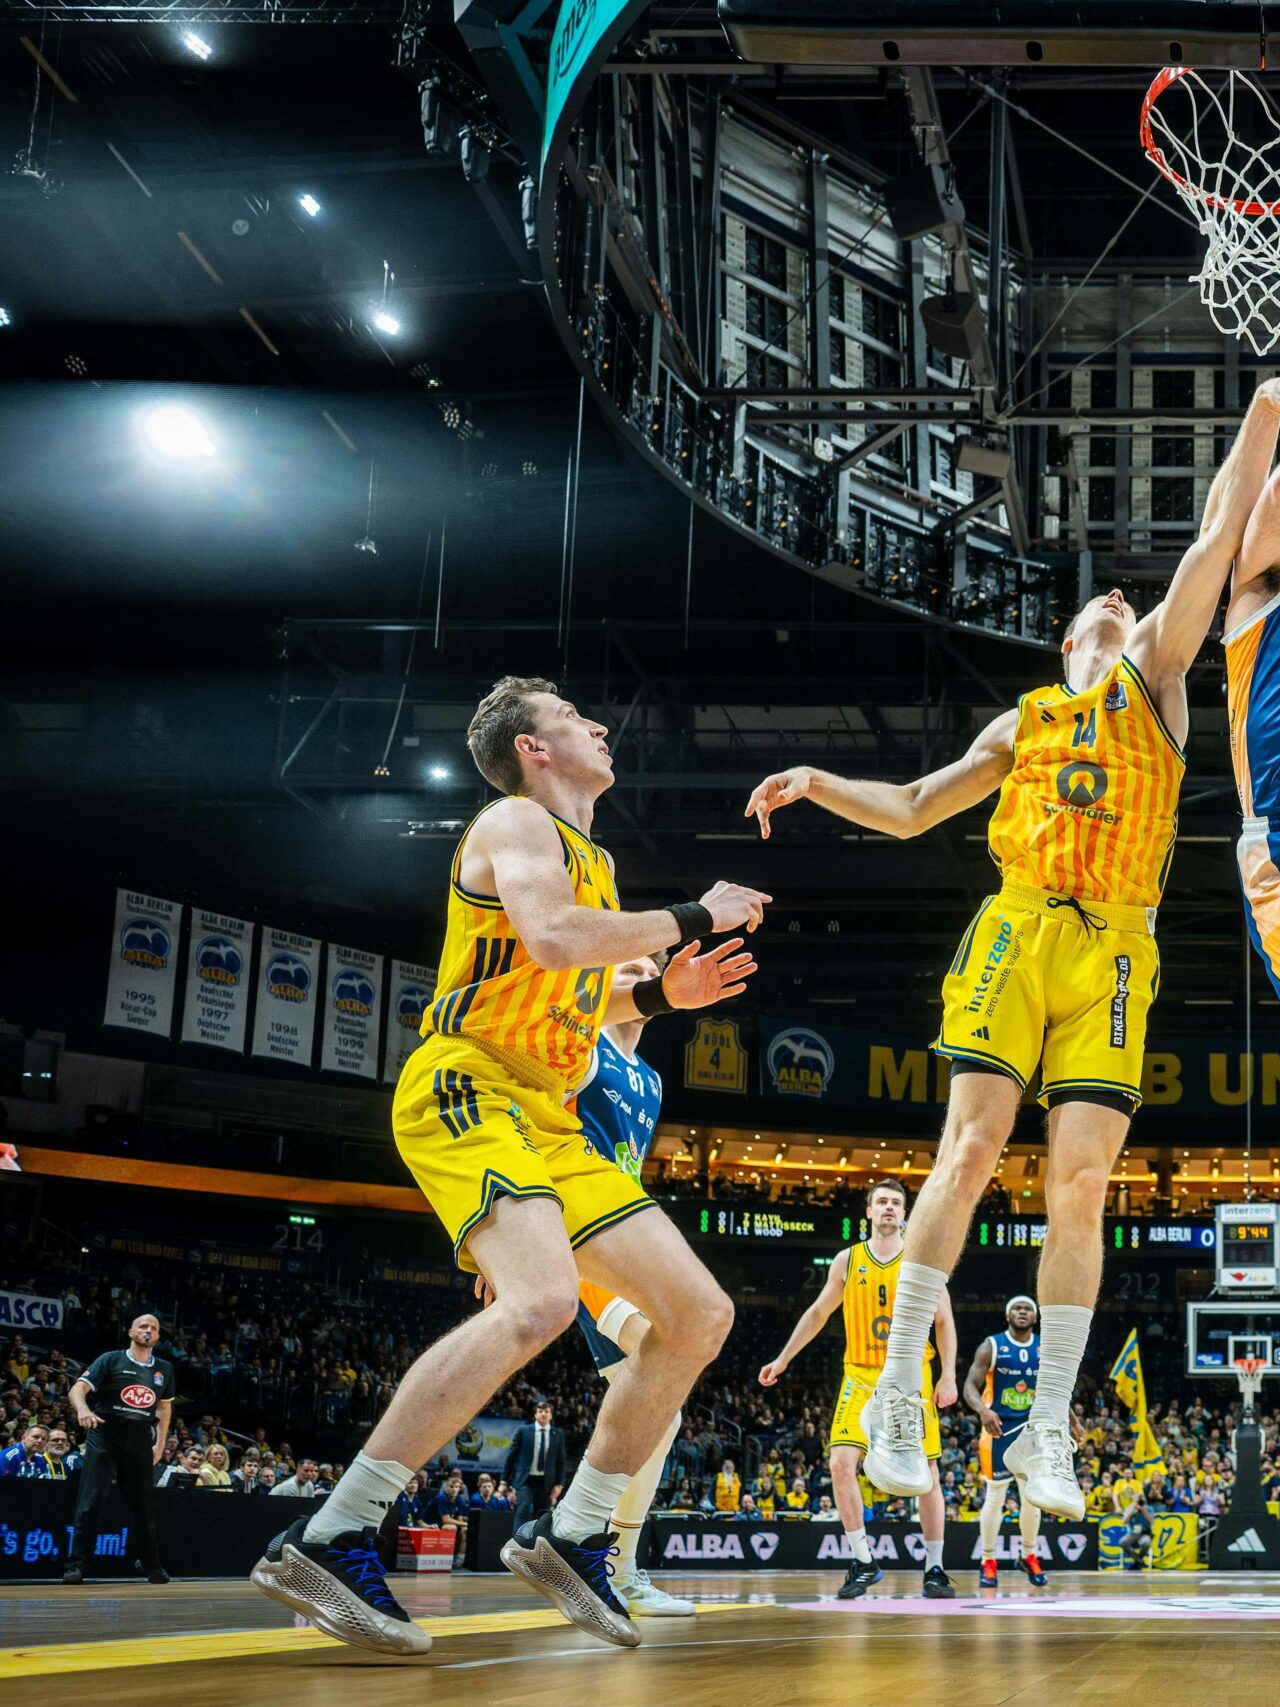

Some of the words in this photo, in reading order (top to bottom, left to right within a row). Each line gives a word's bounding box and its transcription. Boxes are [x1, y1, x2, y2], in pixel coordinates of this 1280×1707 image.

[1071, 707, 1097, 748] 14
[985, 992, 999, 1018] zero
[996, 967, 1011, 998] waste
[202, 1007, 229, 1021] 1997
[709, 1047, 720, 1070] 4
[626, 1066, 645, 1097] 81
[779, 1067, 823, 1085] ALBA
[1224, 1205, 1271, 1215] interzero
[273, 1225, 324, 1251] 214
[1149, 1227, 1166, 1241] ALBA
[1167, 1227, 1191, 1242] BERLIN
[1201, 1229, 1215, 1247] 0
[879, 1284, 887, 1307] 9
[1019, 1349, 1028, 1363] 0
[1005, 1392, 1034, 1405] Karl
[24, 1528, 59, 1562] go,
[663, 1533, 745, 1559] ALBA
